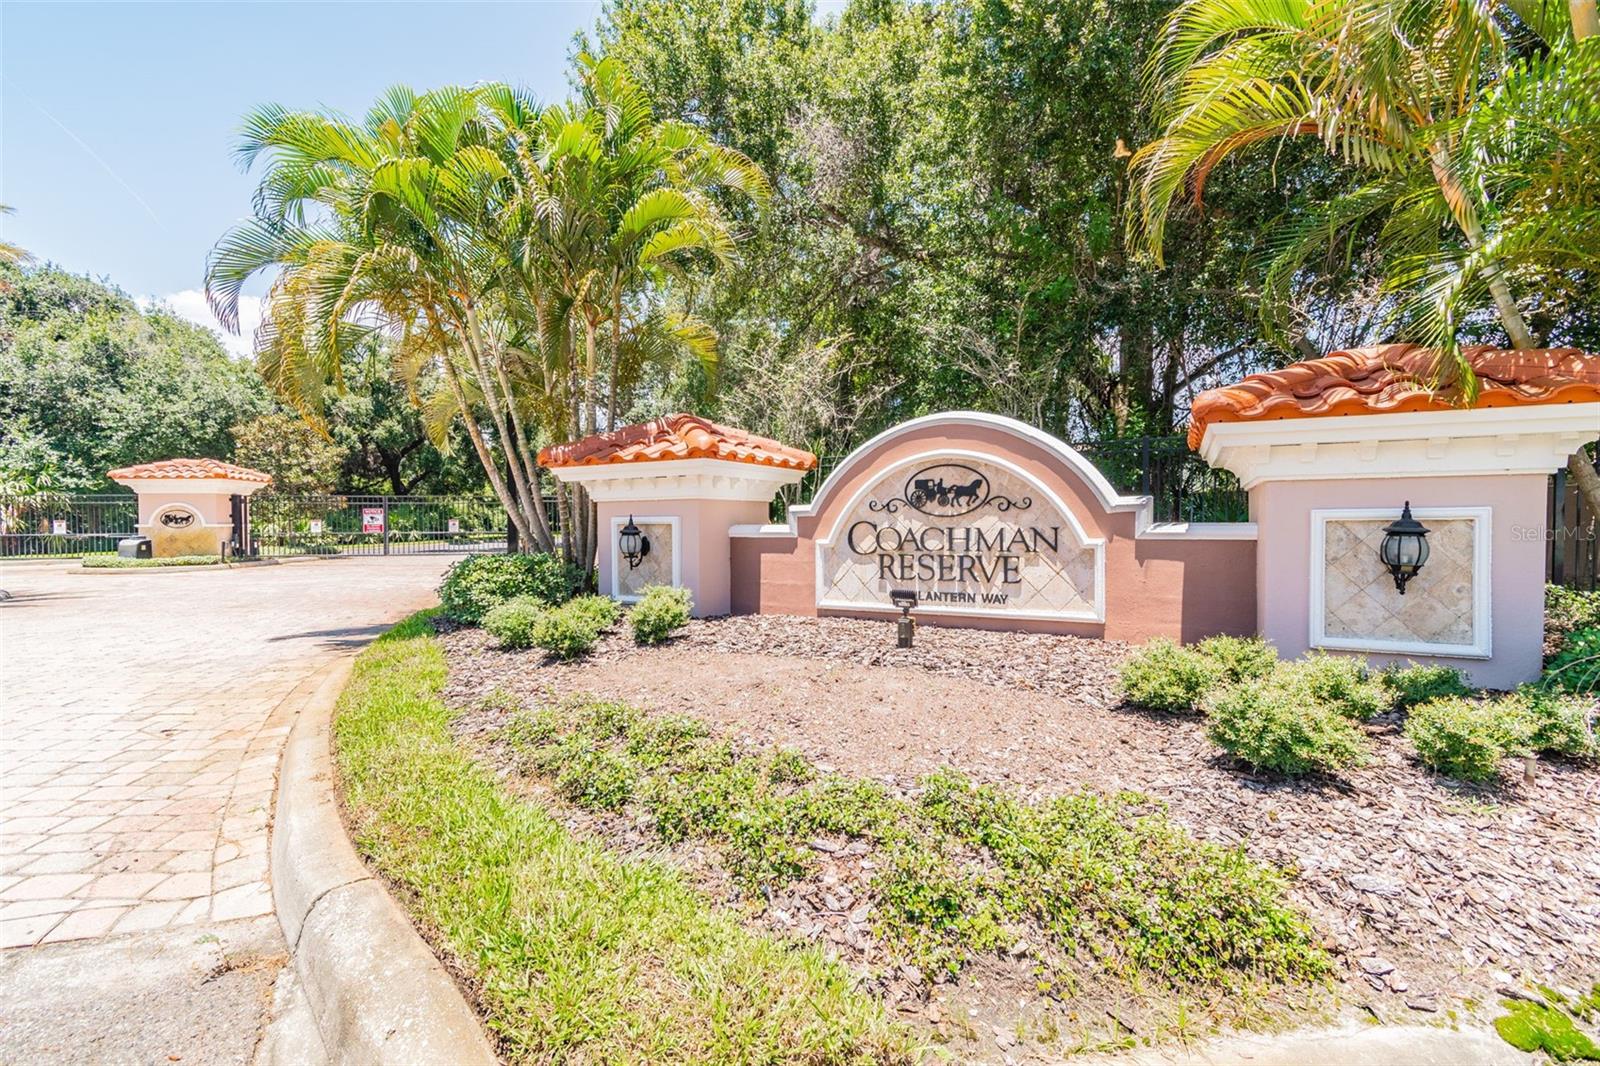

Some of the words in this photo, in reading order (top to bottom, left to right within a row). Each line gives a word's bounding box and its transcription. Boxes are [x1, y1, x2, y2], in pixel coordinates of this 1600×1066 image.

[848, 521, 1059, 555] COACHMAN
[879, 555, 1022, 584] RESERVE
[918, 591, 976, 603] LANTERN
[981, 594, 1008, 605] WAY
